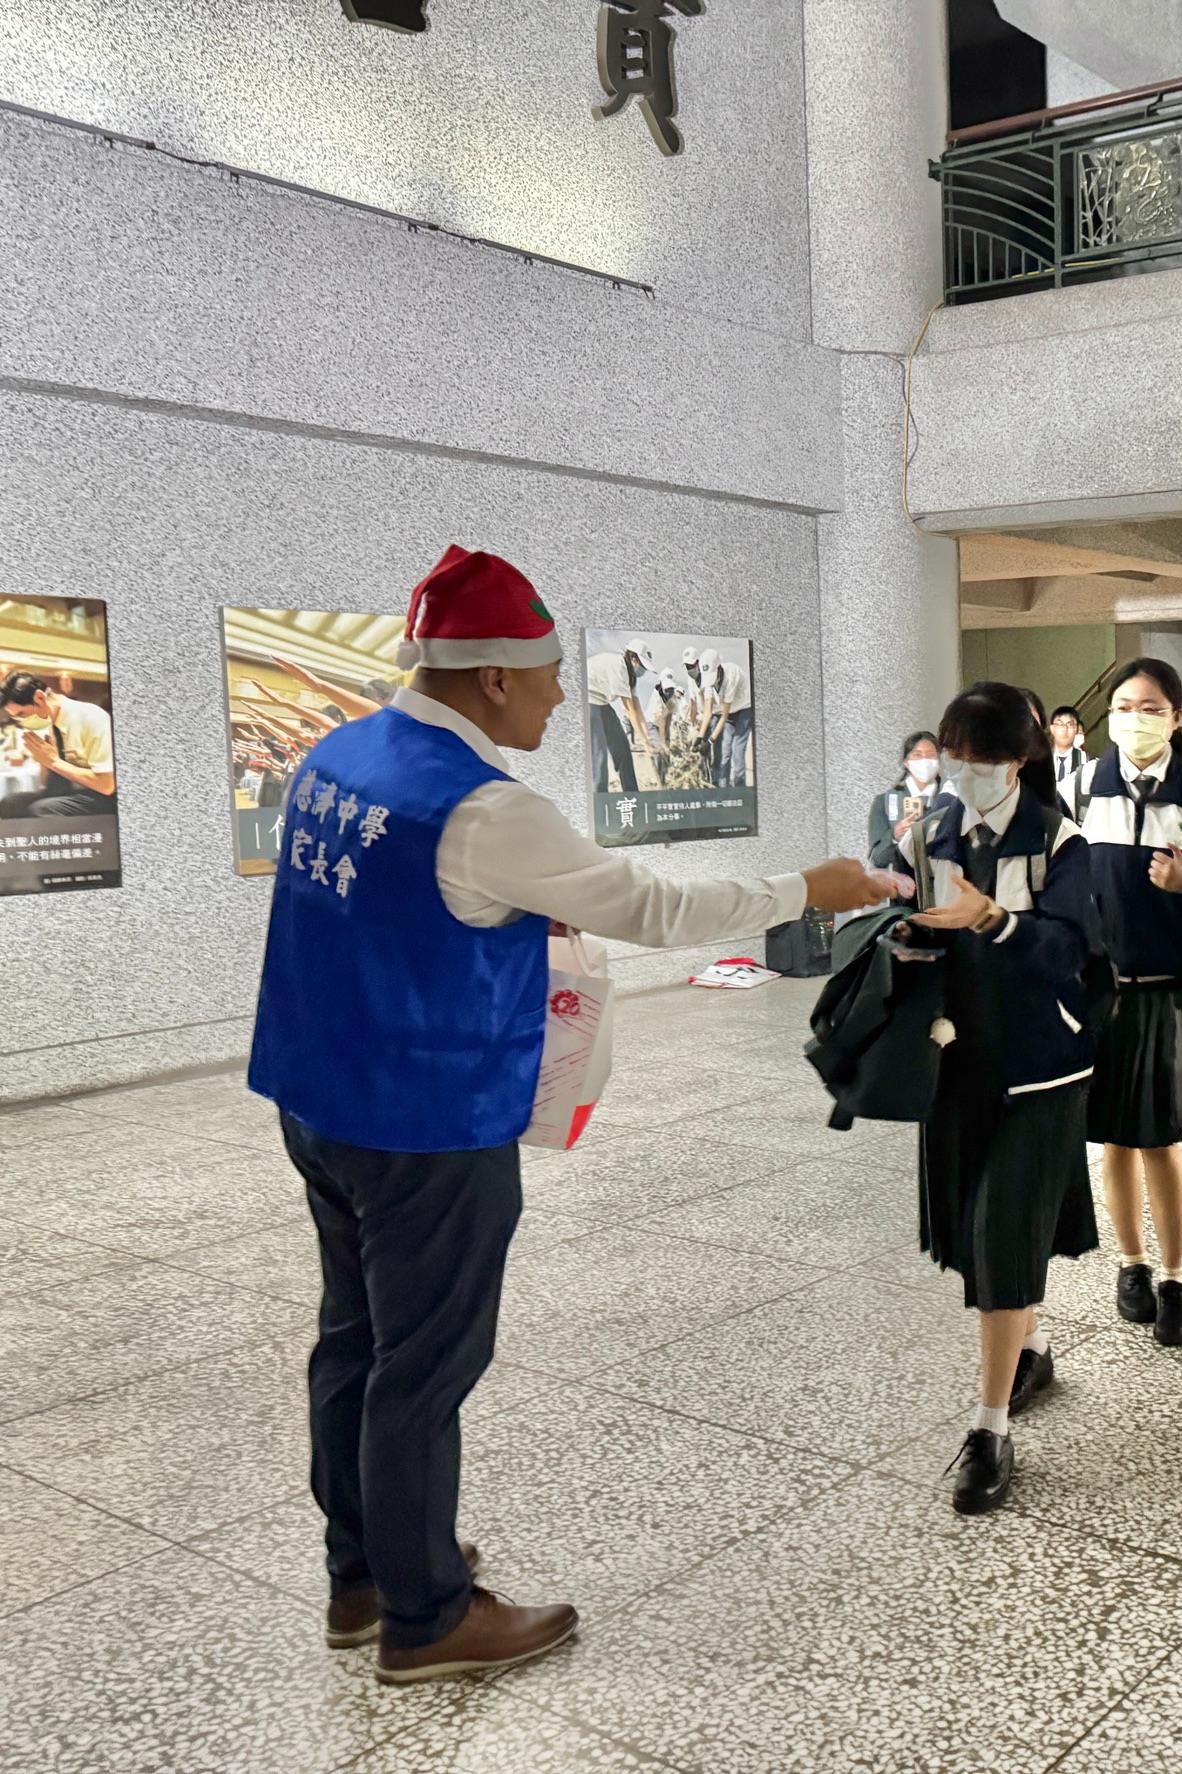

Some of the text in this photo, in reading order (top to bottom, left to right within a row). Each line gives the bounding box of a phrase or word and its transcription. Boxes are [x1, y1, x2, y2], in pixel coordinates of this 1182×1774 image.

[615, 796, 638, 829] 實
[290, 828, 358, 898] 家長會
